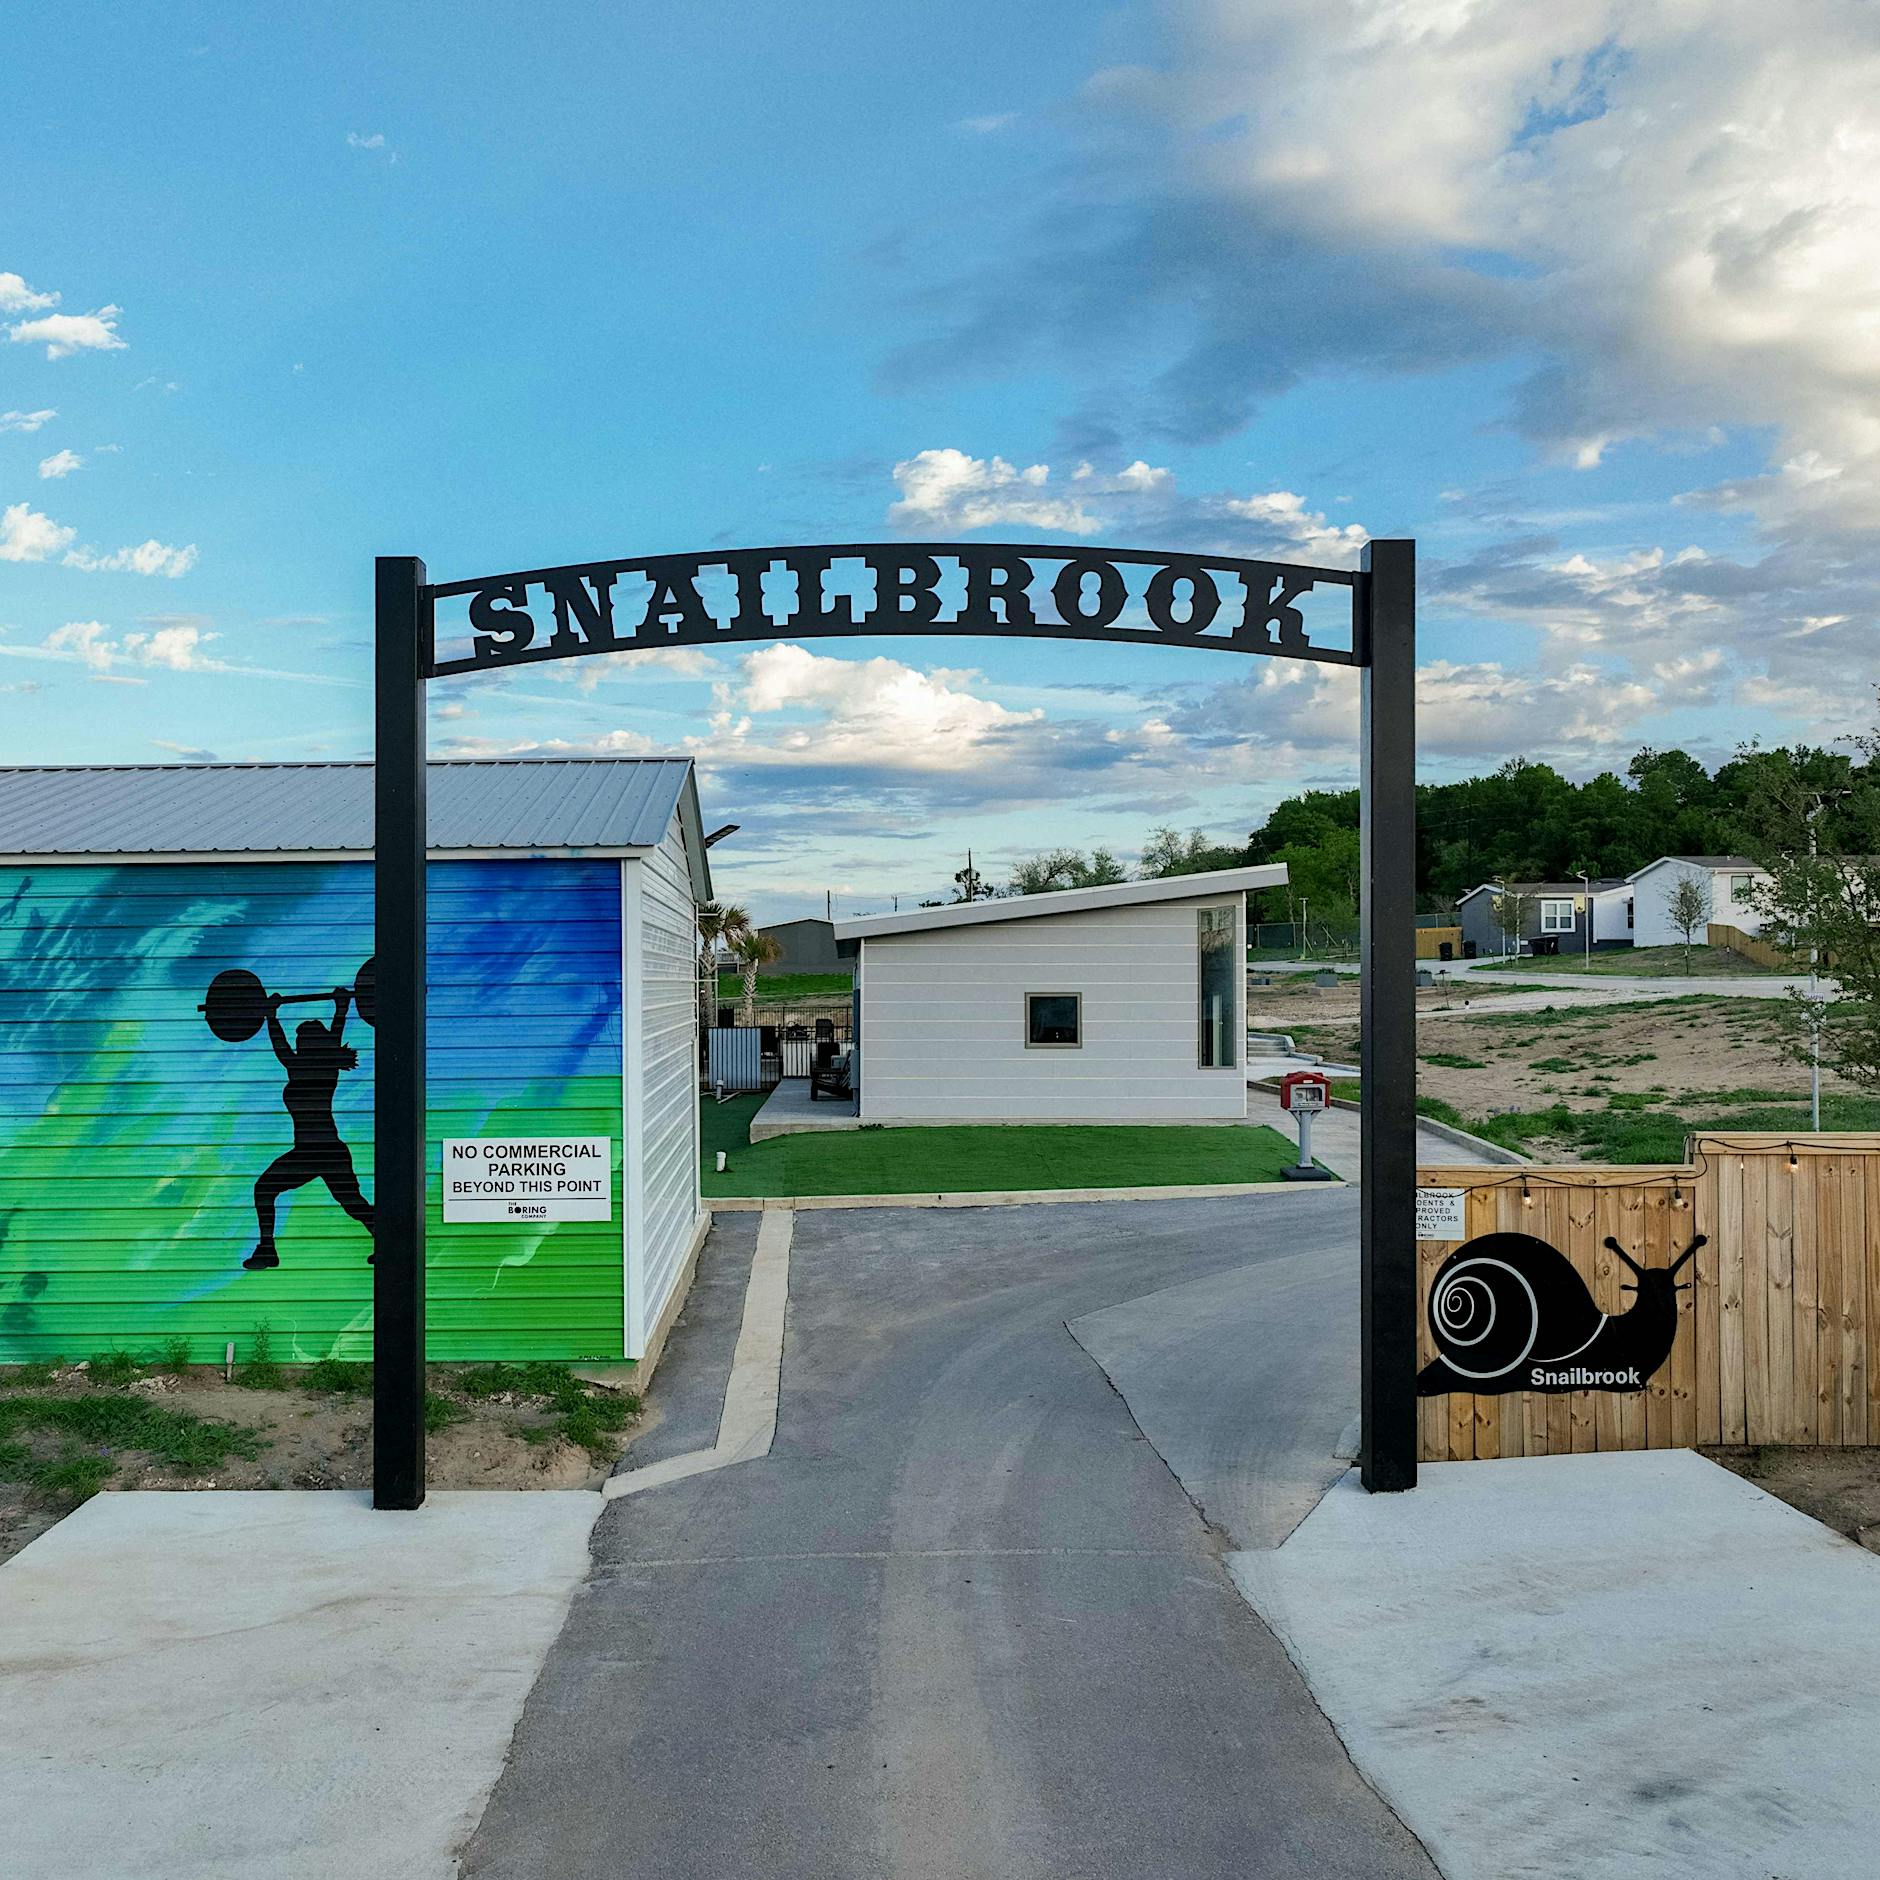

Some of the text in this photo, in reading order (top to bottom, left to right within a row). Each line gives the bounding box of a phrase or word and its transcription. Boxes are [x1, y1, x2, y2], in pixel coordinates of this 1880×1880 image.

[469, 556, 1314, 655] SNAILBROOK
[452, 1144, 602, 1159] NO COMMERCIAL
[488, 1163, 566, 1176] PARKING
[453, 1180, 602, 1193] BEYOND THIS POINT
[1530, 1367, 1641, 1386] Snailbrook
